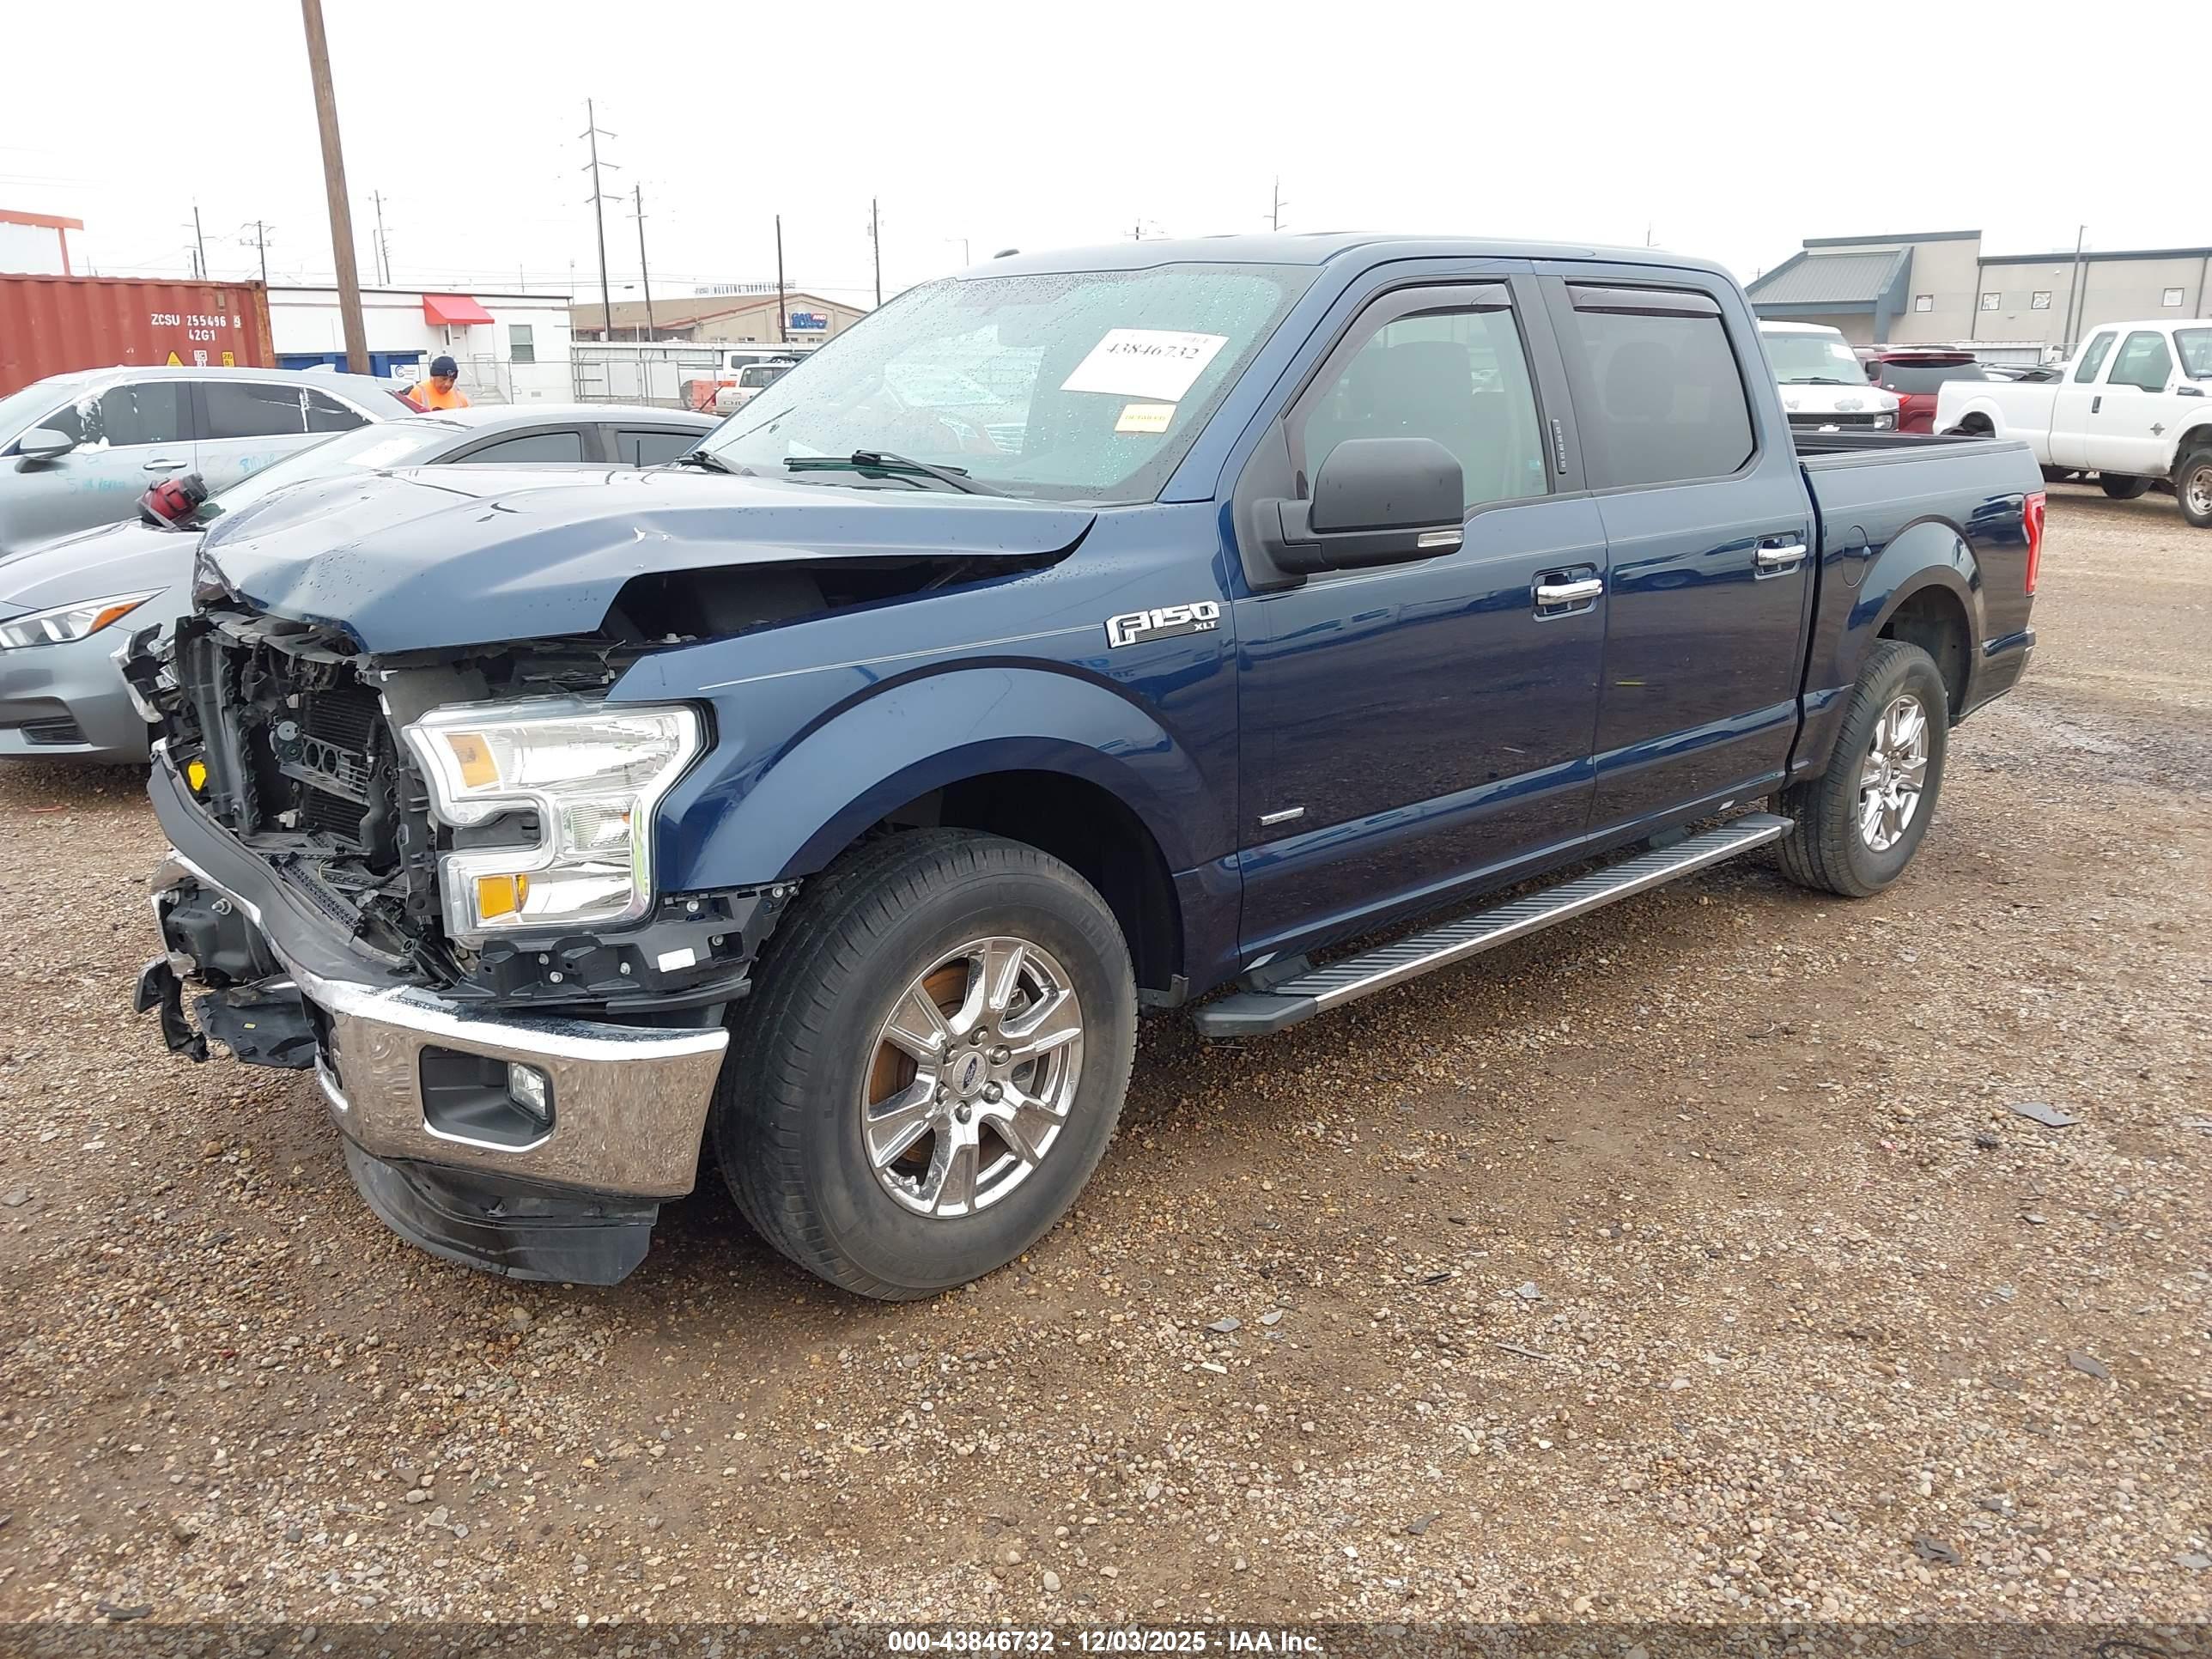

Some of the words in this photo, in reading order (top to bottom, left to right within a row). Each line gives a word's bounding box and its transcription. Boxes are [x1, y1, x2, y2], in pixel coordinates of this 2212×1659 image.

[150, 314, 180, 325] ZCSU
[186, 315, 227, 327] 255496
[189, 329, 216, 341] 42G1
[1106, 343, 1200, 359] 43846732
[1194, 621, 1217, 632] XLT
